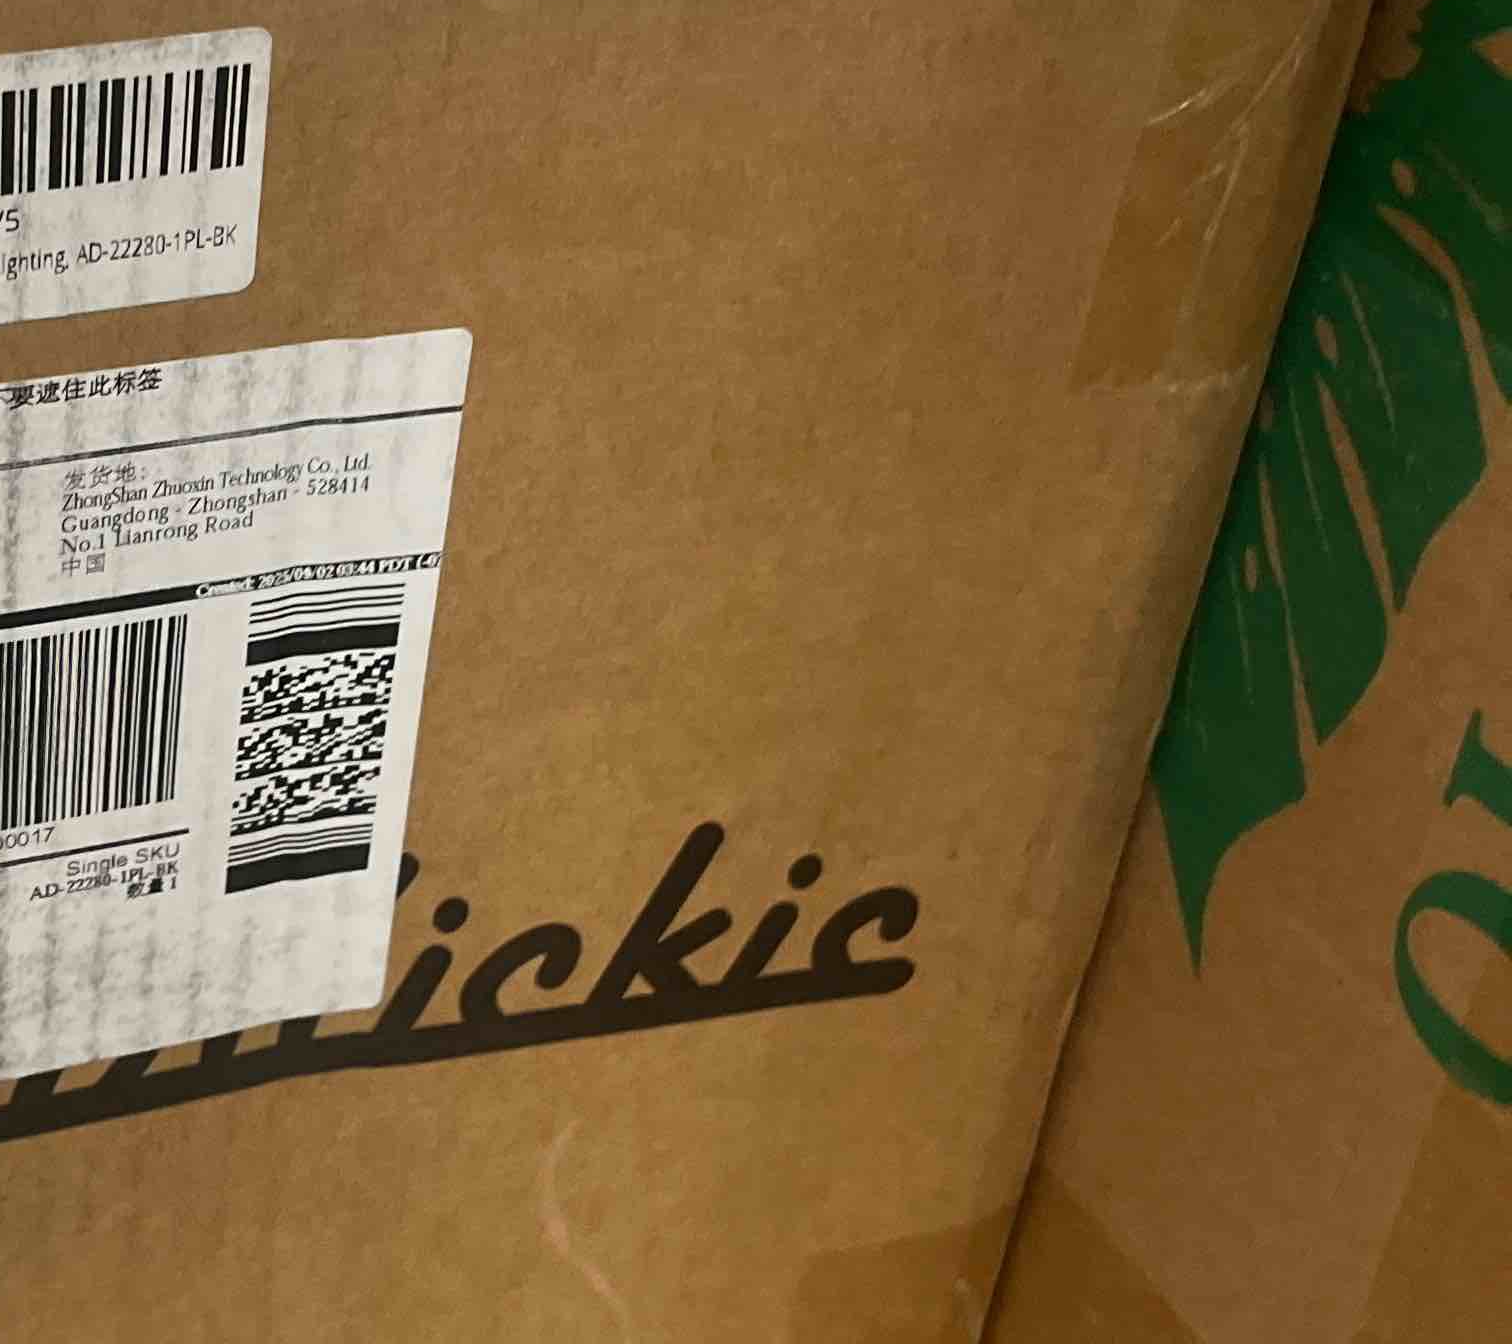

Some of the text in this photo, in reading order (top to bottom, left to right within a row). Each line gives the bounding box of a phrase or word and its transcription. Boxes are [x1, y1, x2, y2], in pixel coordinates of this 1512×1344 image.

[218, 463, 304, 490] Technology
[61, 505, 170, 534] Guangdong
[187, 485, 288, 516] Zhongshan
[204, 510, 254, 535] Road
[61, 552, 106, 578] 中国
[66, 842, 180, 877] Single SKU
